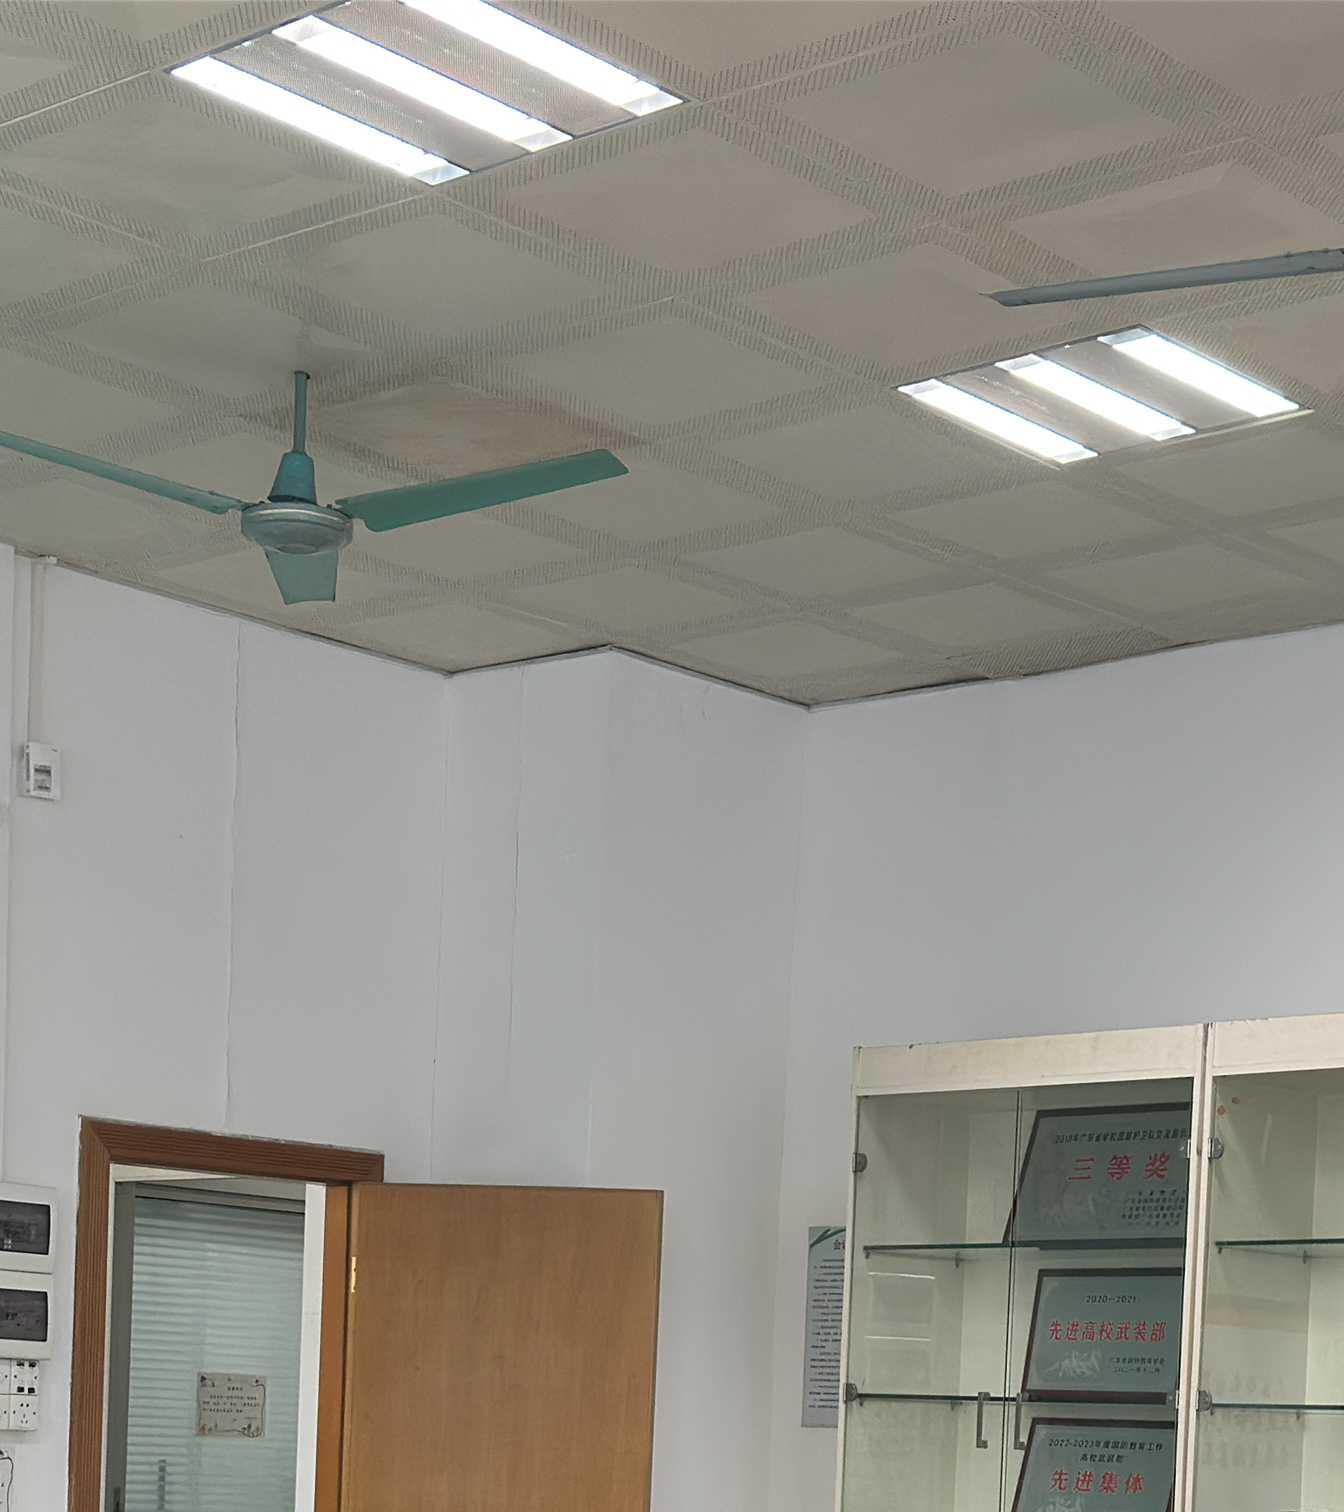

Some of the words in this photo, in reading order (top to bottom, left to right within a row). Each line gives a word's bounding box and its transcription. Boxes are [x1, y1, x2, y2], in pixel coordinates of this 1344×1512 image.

[1067, 1151, 1172, 1182] 三等奖
[1048, 1319, 1168, 1343] 先进高校武装部
[1049, 1468, 1145, 1495] 先进集体
